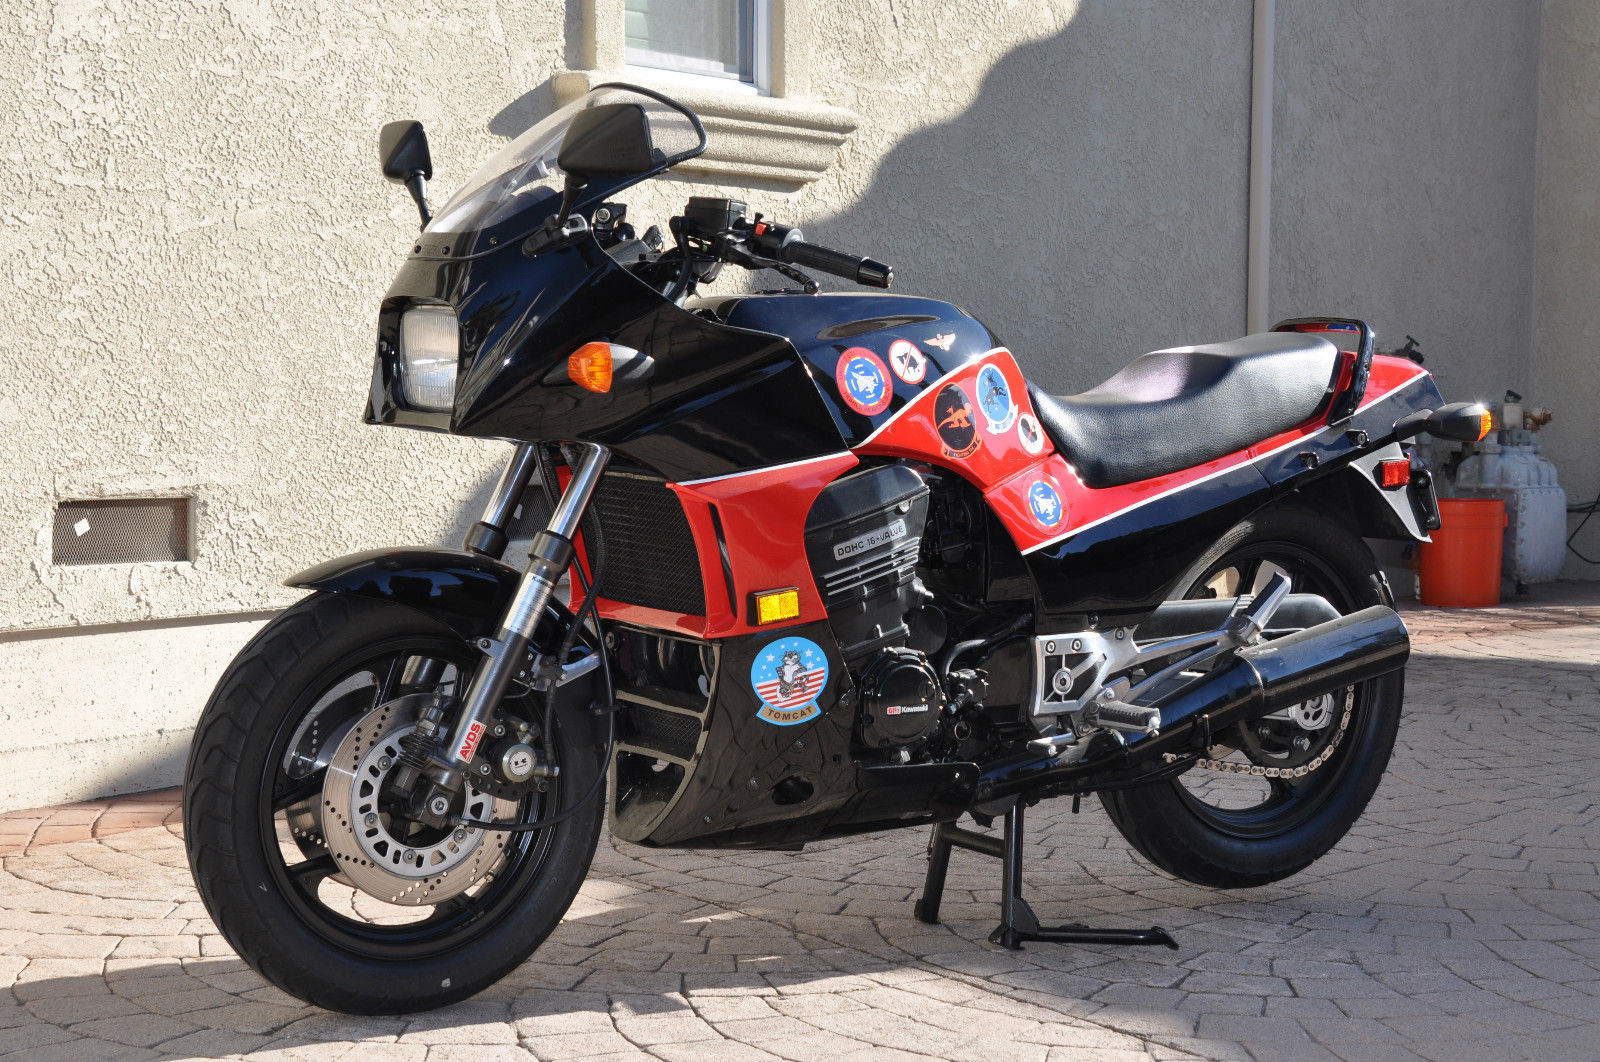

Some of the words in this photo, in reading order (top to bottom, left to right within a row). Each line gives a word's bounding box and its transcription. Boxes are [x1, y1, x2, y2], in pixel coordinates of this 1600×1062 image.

[837, 541, 864, 556] DOHC
[767, 706, 813, 721] TOMCAT
[459, 722, 481, 760] AVDS
